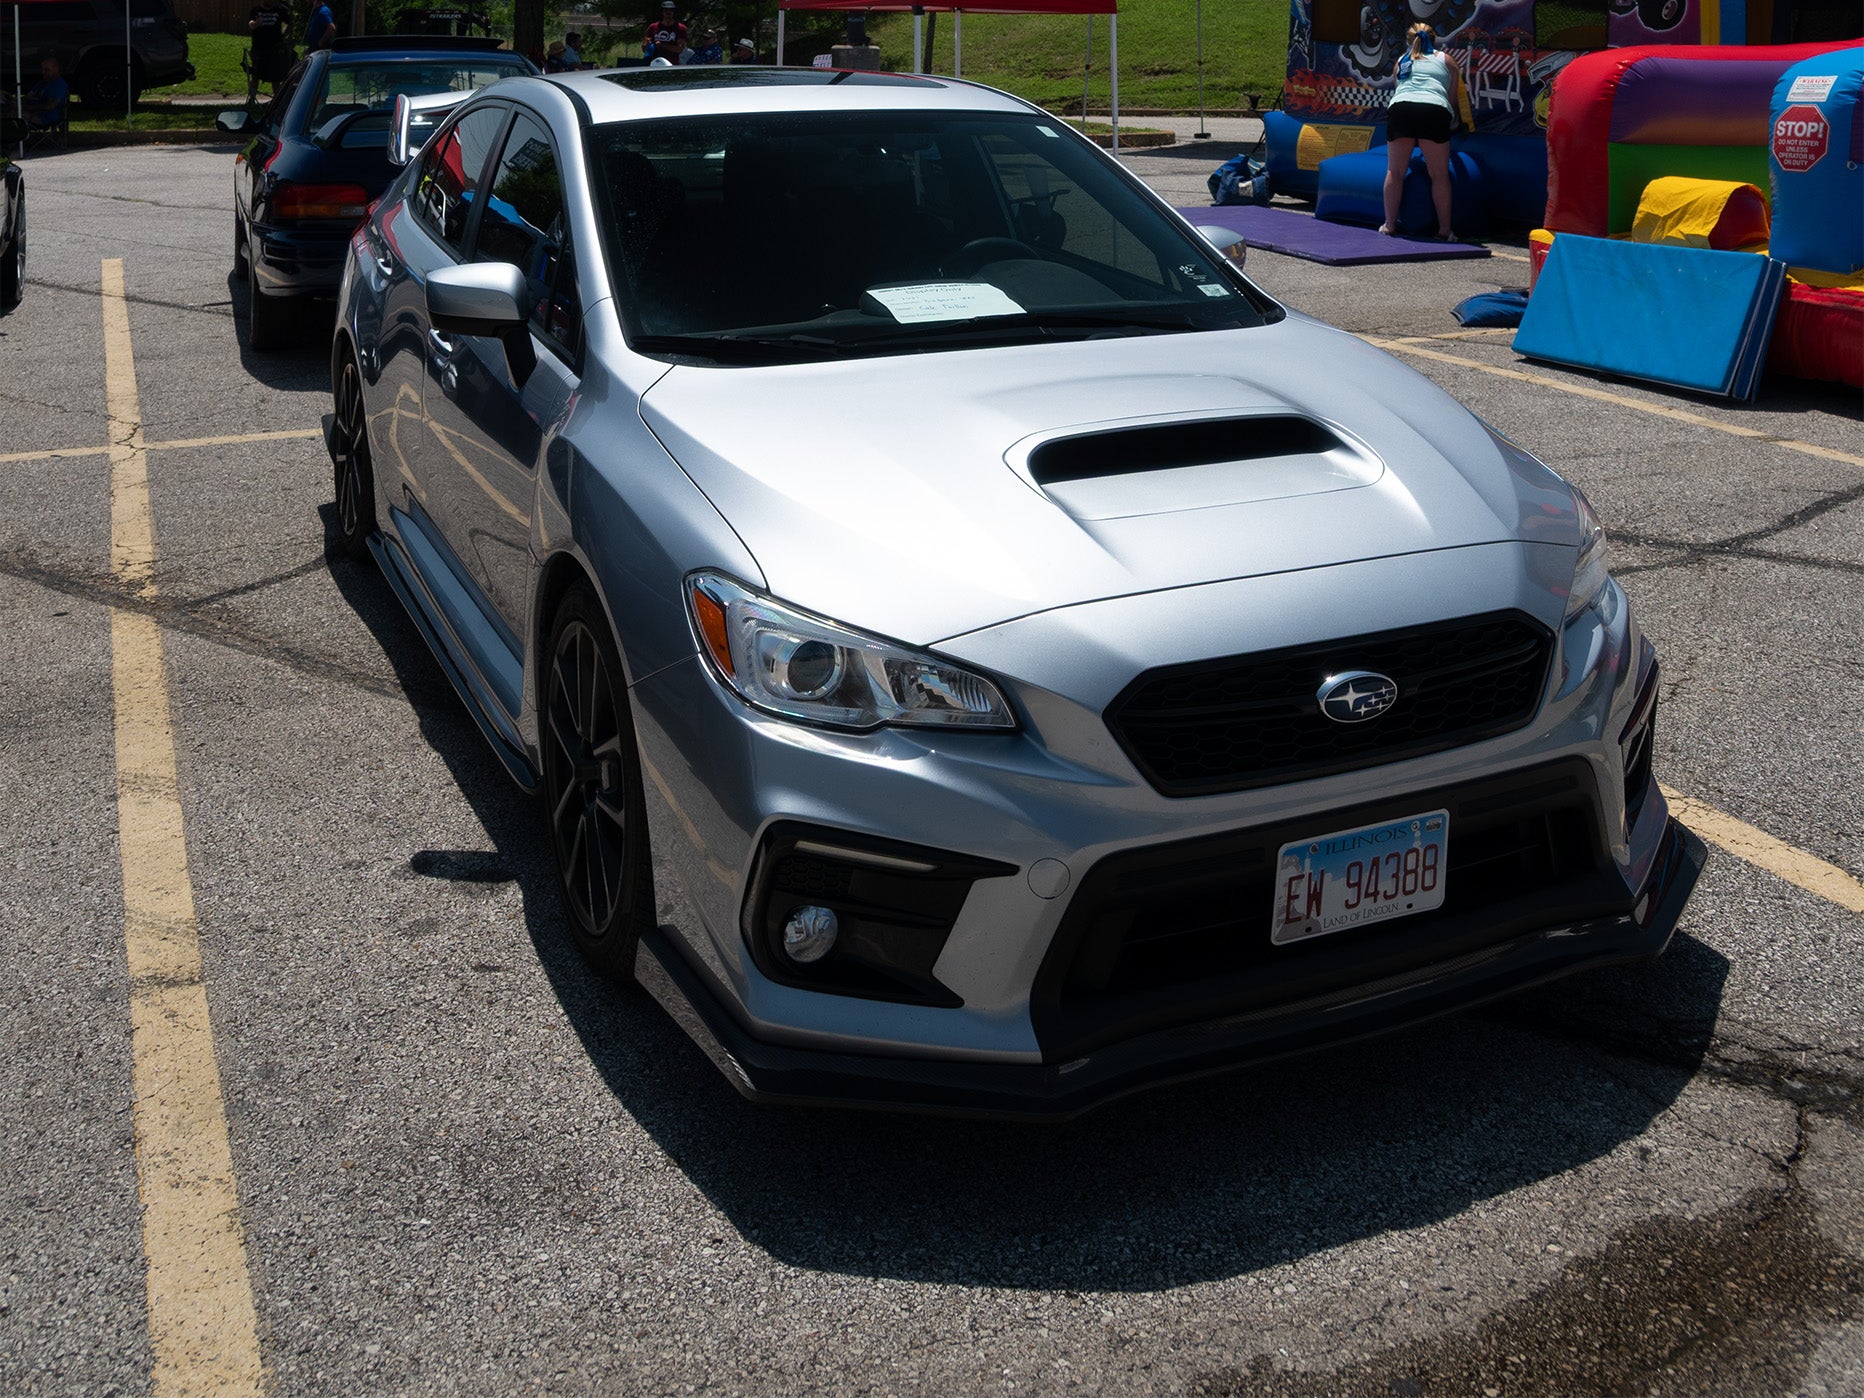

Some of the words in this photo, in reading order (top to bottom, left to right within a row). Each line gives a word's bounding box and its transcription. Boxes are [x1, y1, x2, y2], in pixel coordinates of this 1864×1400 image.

[1777, 121, 1824, 138] STOP!
[1326, 826, 1407, 855] ILLINOIS
[1285, 870, 1325, 924] EW
[1345, 844, 1439, 909] 94388
[1323, 915, 1348, 928] LAND
[1349, 911, 1362, 922] OF
[1362, 902, 1400, 919] LINCOLN
